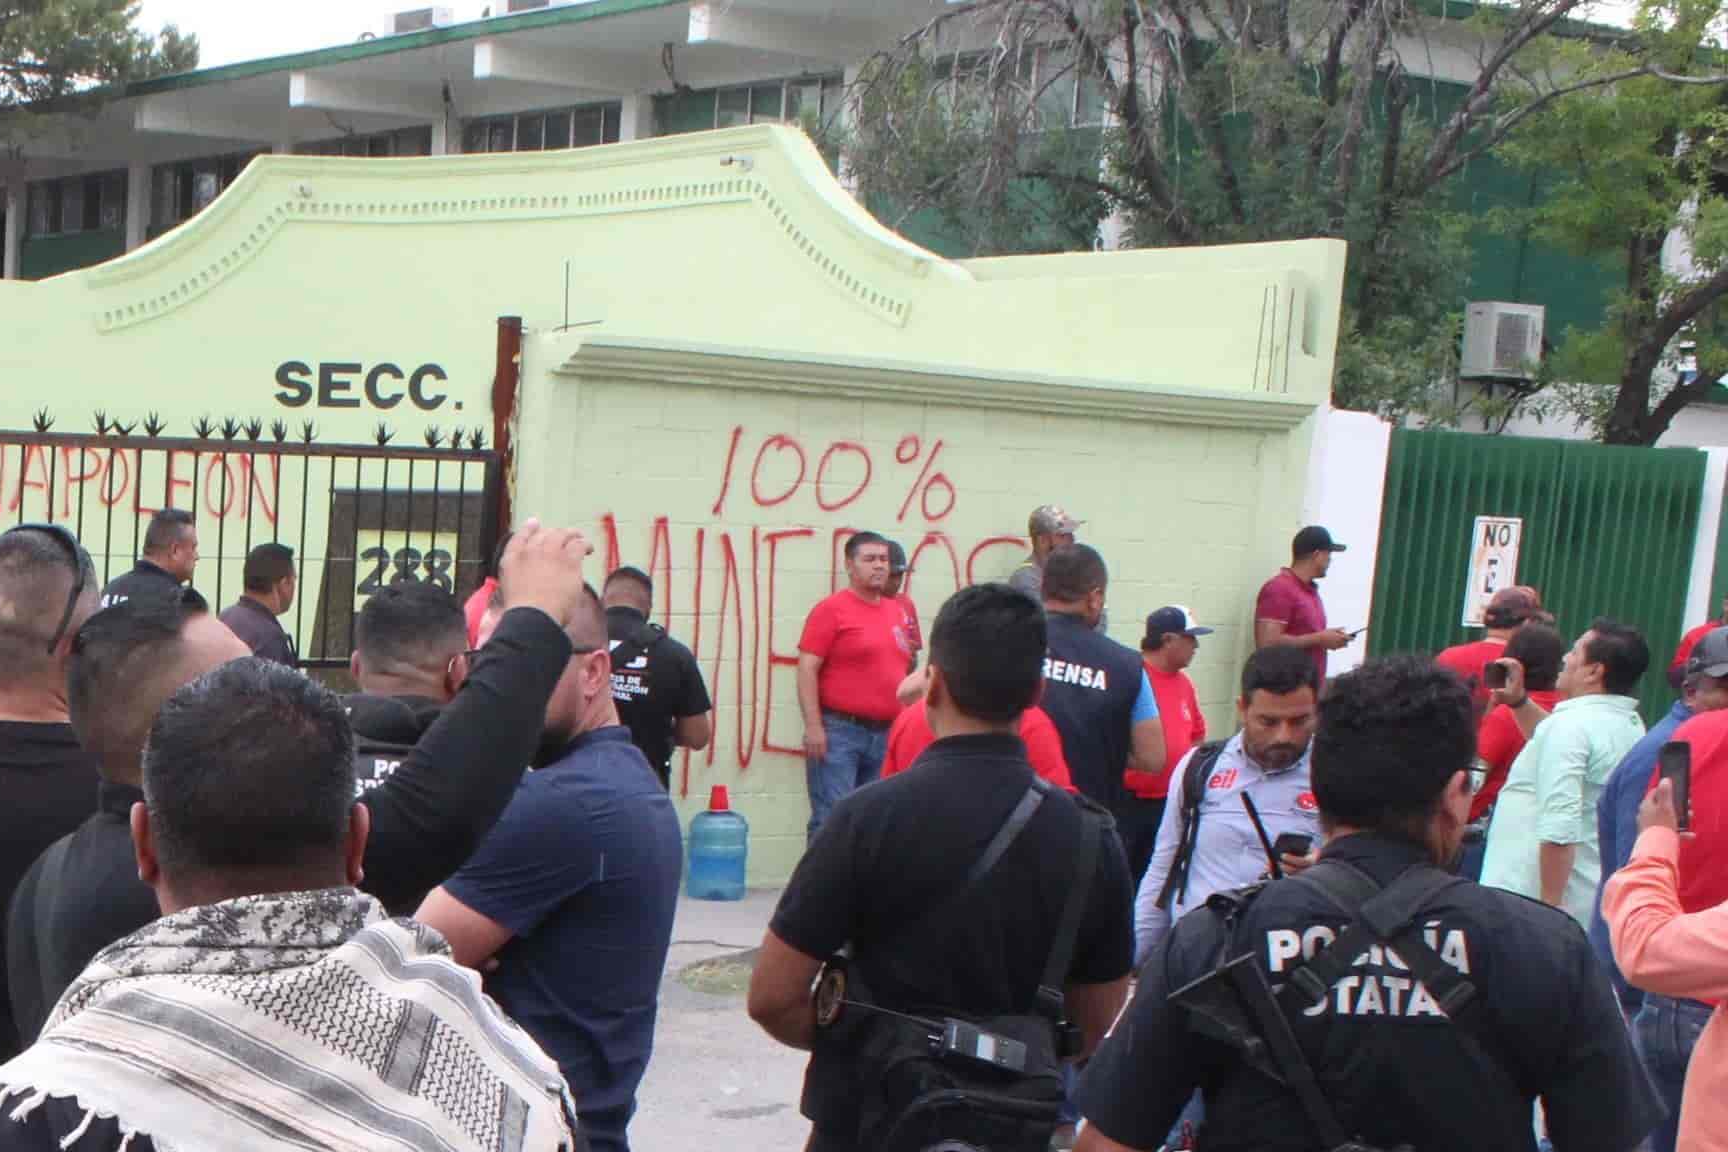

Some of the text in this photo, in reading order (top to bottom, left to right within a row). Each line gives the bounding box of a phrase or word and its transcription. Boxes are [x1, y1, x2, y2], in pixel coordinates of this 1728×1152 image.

[274, 360, 464, 410] SECC.
[712, 422, 957, 522] 100%
[1483, 524, 1512, 547] NO
[357, 546, 453, 594] 288
[1042, 657, 1107, 691] RENSA
